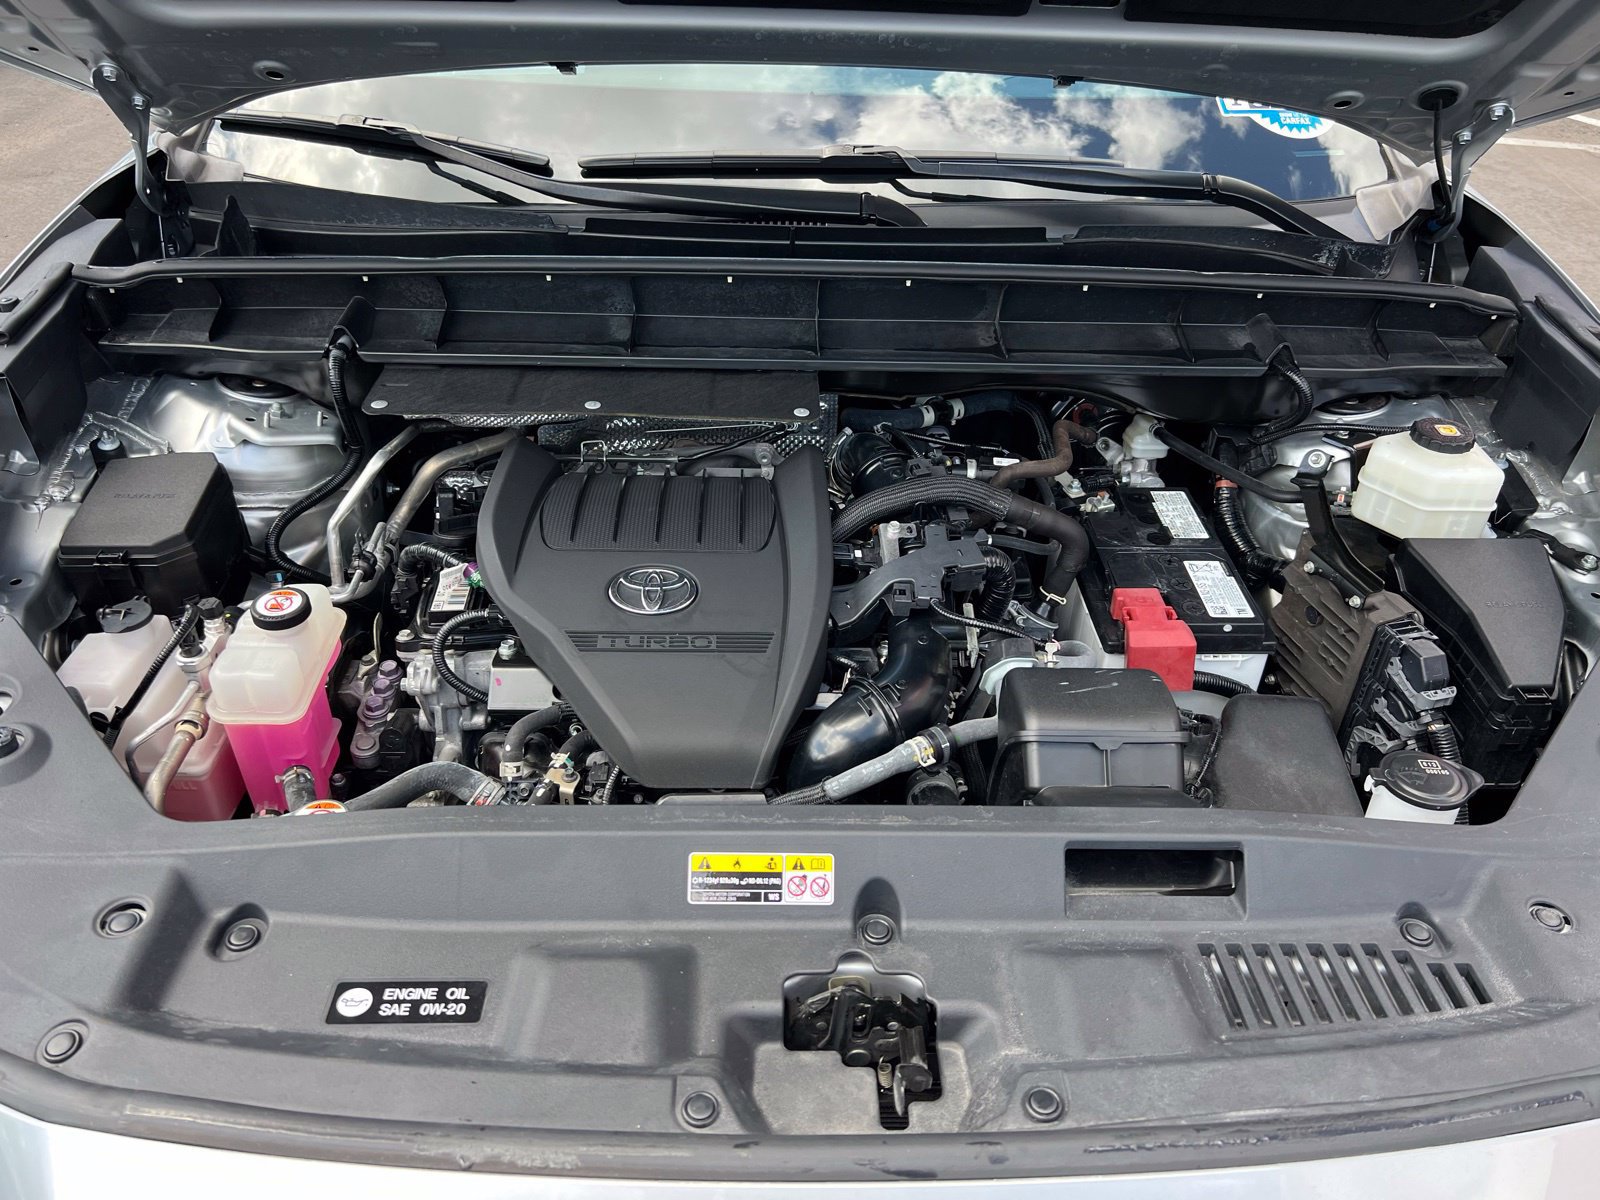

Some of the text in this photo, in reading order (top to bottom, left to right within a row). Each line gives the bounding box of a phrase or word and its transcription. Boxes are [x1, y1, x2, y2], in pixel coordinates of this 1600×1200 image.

[1280, 117, 1311, 125] CARFAX
[601, 635, 713, 648] TURBO
[382, 987, 470, 1000] ENGINE OIL
[378, 1003, 466, 1016] SAE 0W-20
